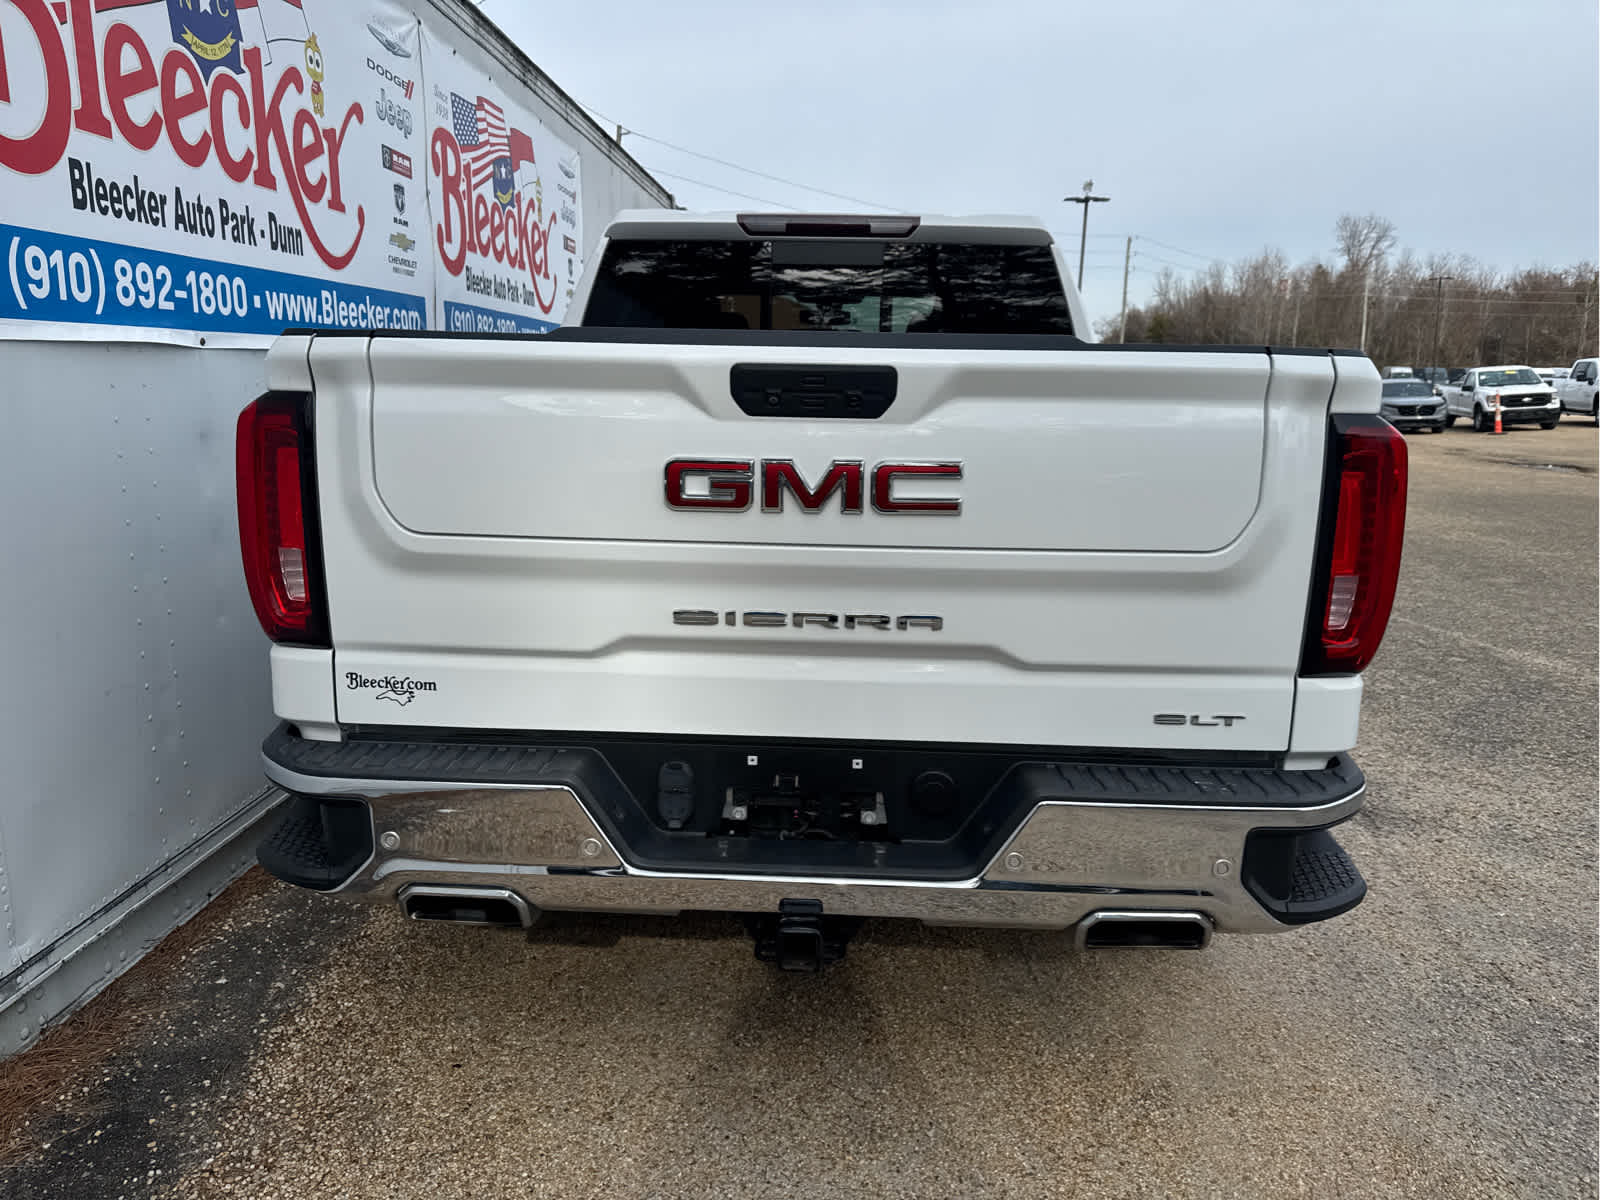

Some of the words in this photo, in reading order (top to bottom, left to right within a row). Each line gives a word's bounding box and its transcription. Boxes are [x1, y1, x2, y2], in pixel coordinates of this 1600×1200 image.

[366, 57, 409, 91] DODGE
[376, 87, 413, 140] Jeep
[68, 156, 167, 228] Bleecker
[174, 186, 215, 238] Auto
[219, 198, 258, 247] Park
[268, 211, 304, 256] Dunn
[431, 127, 557, 315] Bleecker
[9, 236, 106, 315] (910)
[114, 258, 248, 318] 892-1800
[265, 290, 421, 330] www.Bleecker.com
[387, 255, 418, 269] CHEVROLET
[465, 264, 493, 297] Bleecker
[493, 274, 507, 301] Auto
[507, 277, 520, 304] Park
[522, 282, 536, 307] Dunn
[450, 306, 476, 333] (910)
[664, 456, 964, 516] GMC
[672, 608, 944, 631] SIERRA
[1152, 713, 1247, 727] SLT
